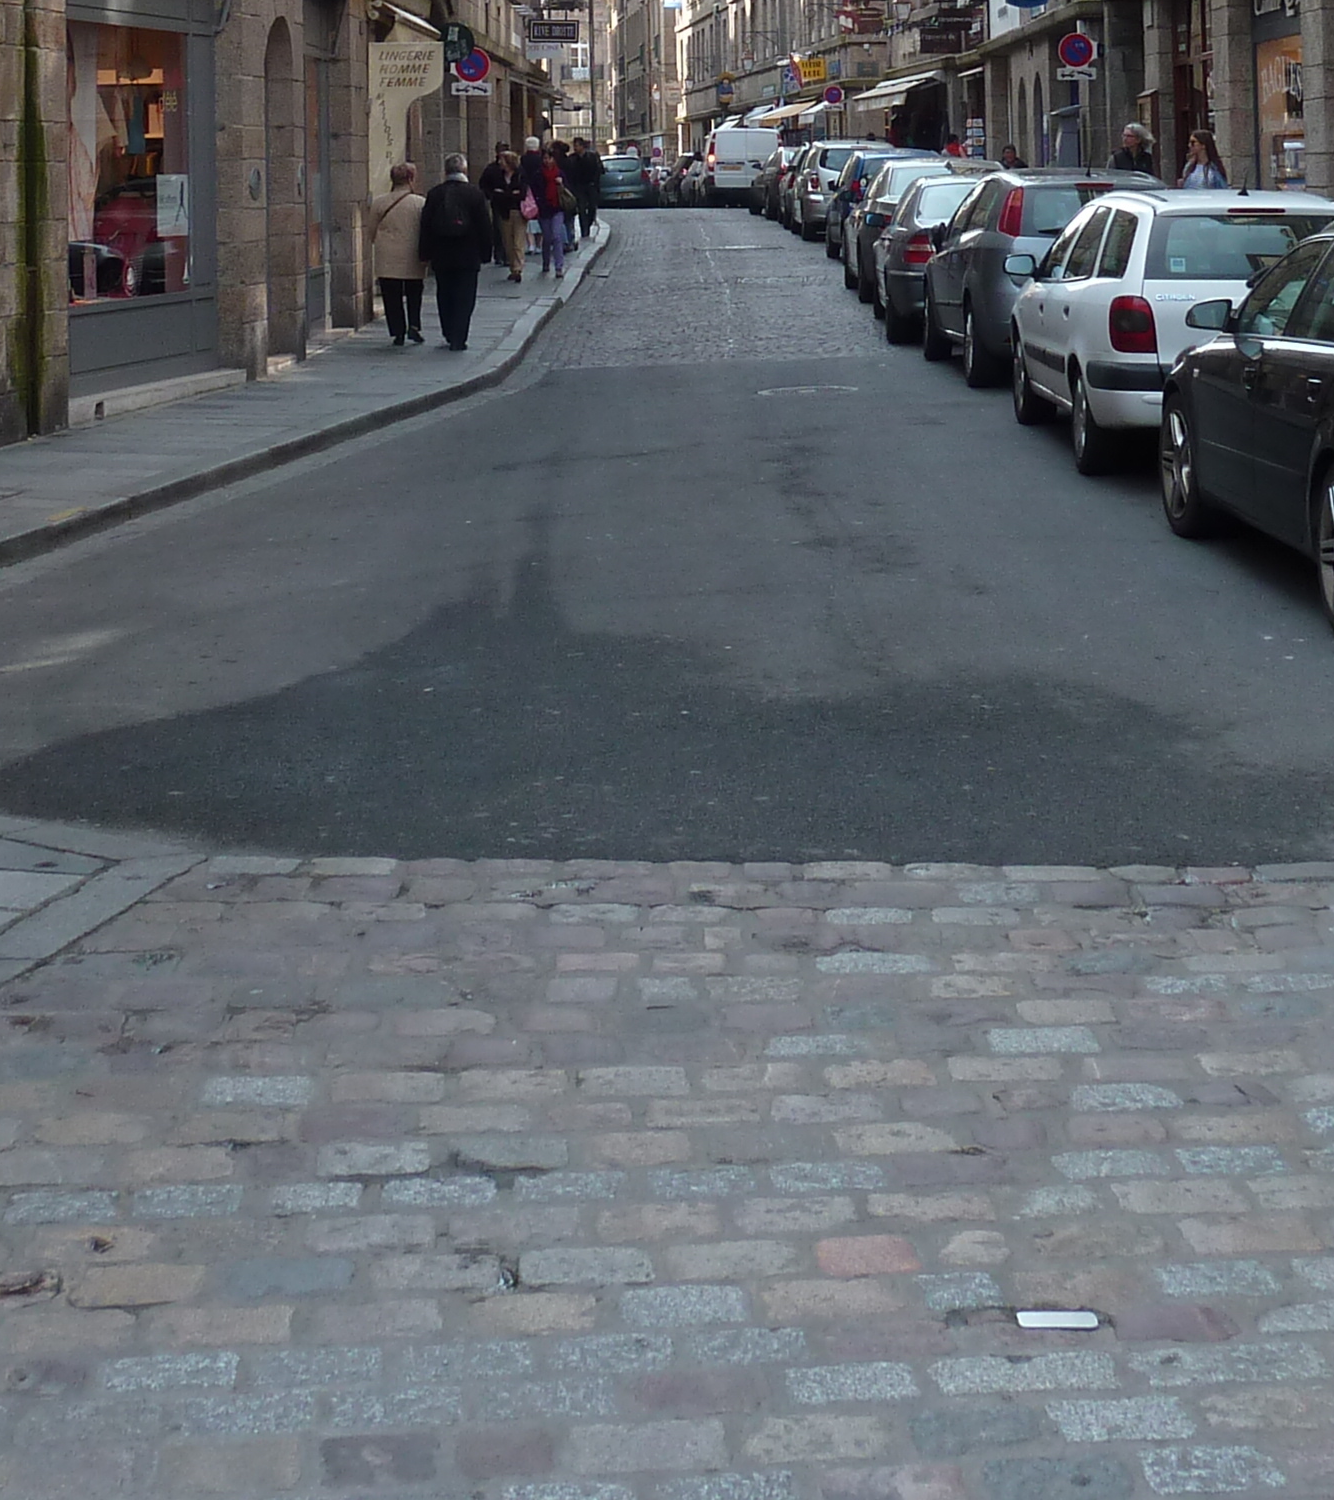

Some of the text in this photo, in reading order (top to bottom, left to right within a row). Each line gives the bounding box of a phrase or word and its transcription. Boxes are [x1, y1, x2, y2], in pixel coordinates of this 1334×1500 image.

[379, 50, 436, 61] LINGERIE
[379, 63, 430, 75] HOMME
[379, 76, 427, 88] FEMME
